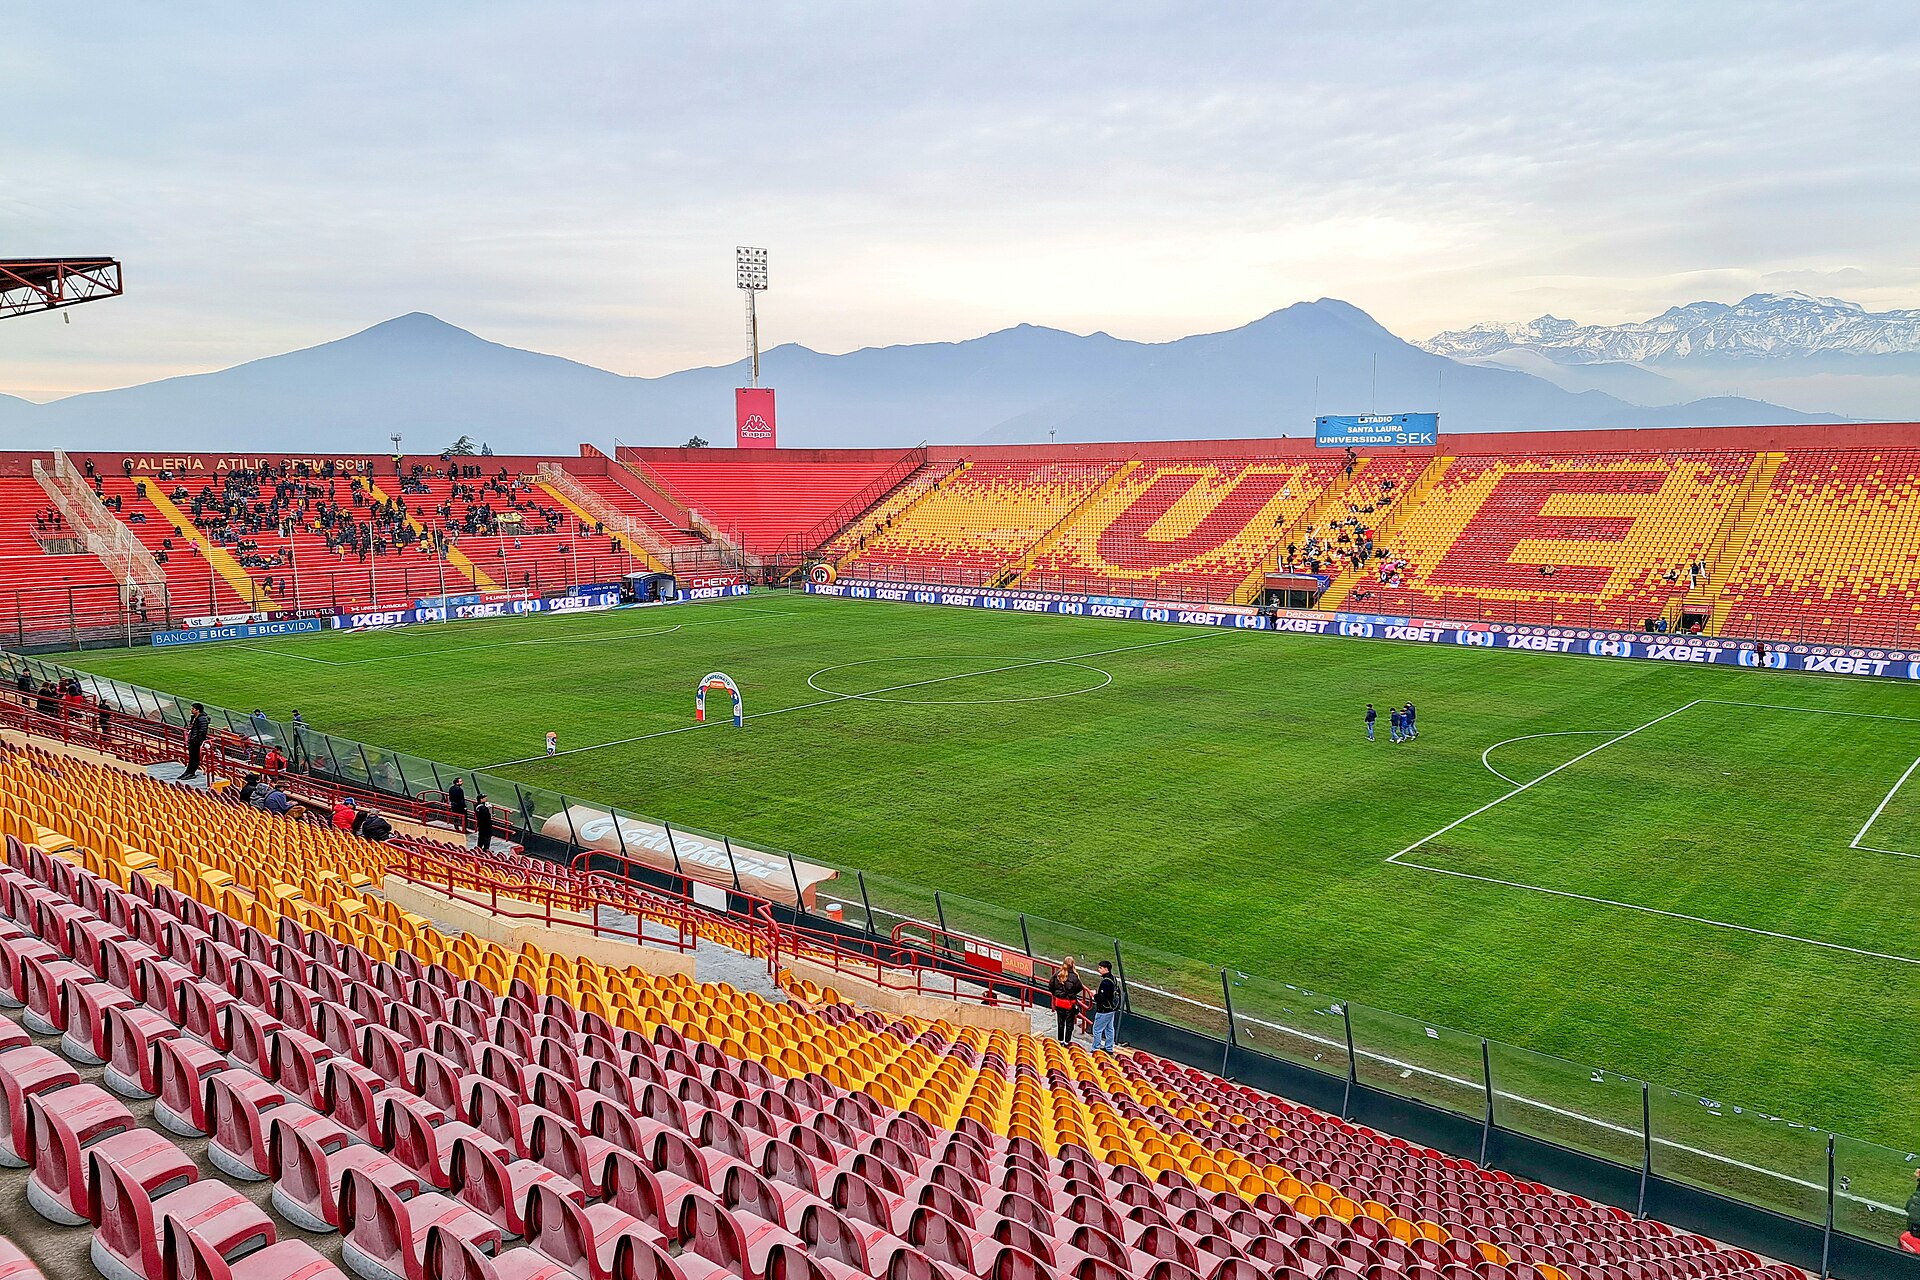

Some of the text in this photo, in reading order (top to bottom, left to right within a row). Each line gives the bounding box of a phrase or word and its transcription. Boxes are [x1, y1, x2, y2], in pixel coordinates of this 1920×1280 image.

[741, 431, 771, 439] Kappa
[1375, 425, 1403, 433] LAURA
[1319, 432, 1433, 444] UNIVERSIDAD SEK
[122, 455, 204, 470] GALERÍA
[693, 576, 737, 588] CHERY
[815, 569, 826, 582] PF
[690, 586, 726, 600] 1XBET
[815, 584, 846, 597] 1XBET
[876, 588, 909, 601] 1XBET
[548, 595, 592, 610] 1XBET
[941, 594, 977, 607] 1XBET
[1012, 599, 1052, 612] 1XBET
[1146, 601, 1201, 610] CHERY
[1090, 605, 1135, 619] 1XBET
[1208, 604, 1254, 616] Campeonato
[1286, 610, 1325, 619] betsson
[351, 610, 406, 627] 1XBET
[1178, 611, 1227, 626] 1XBET
[1422, 620, 1473, 630] CHERY
[259, 621, 313, 635] BICE VIDA
[1276, 617, 1330, 634] 1XBET
[156, 628, 237, 644] BANCO BICE
[1384, 625, 1445, 643] 1XBET
[1506, 634, 1576, 652] 1XBET
[1645, 644, 1723, 663] 1XBET
[1803, 655, 1891, 676] 1XBET
[1005, 958, 1030, 971] SALIDA
